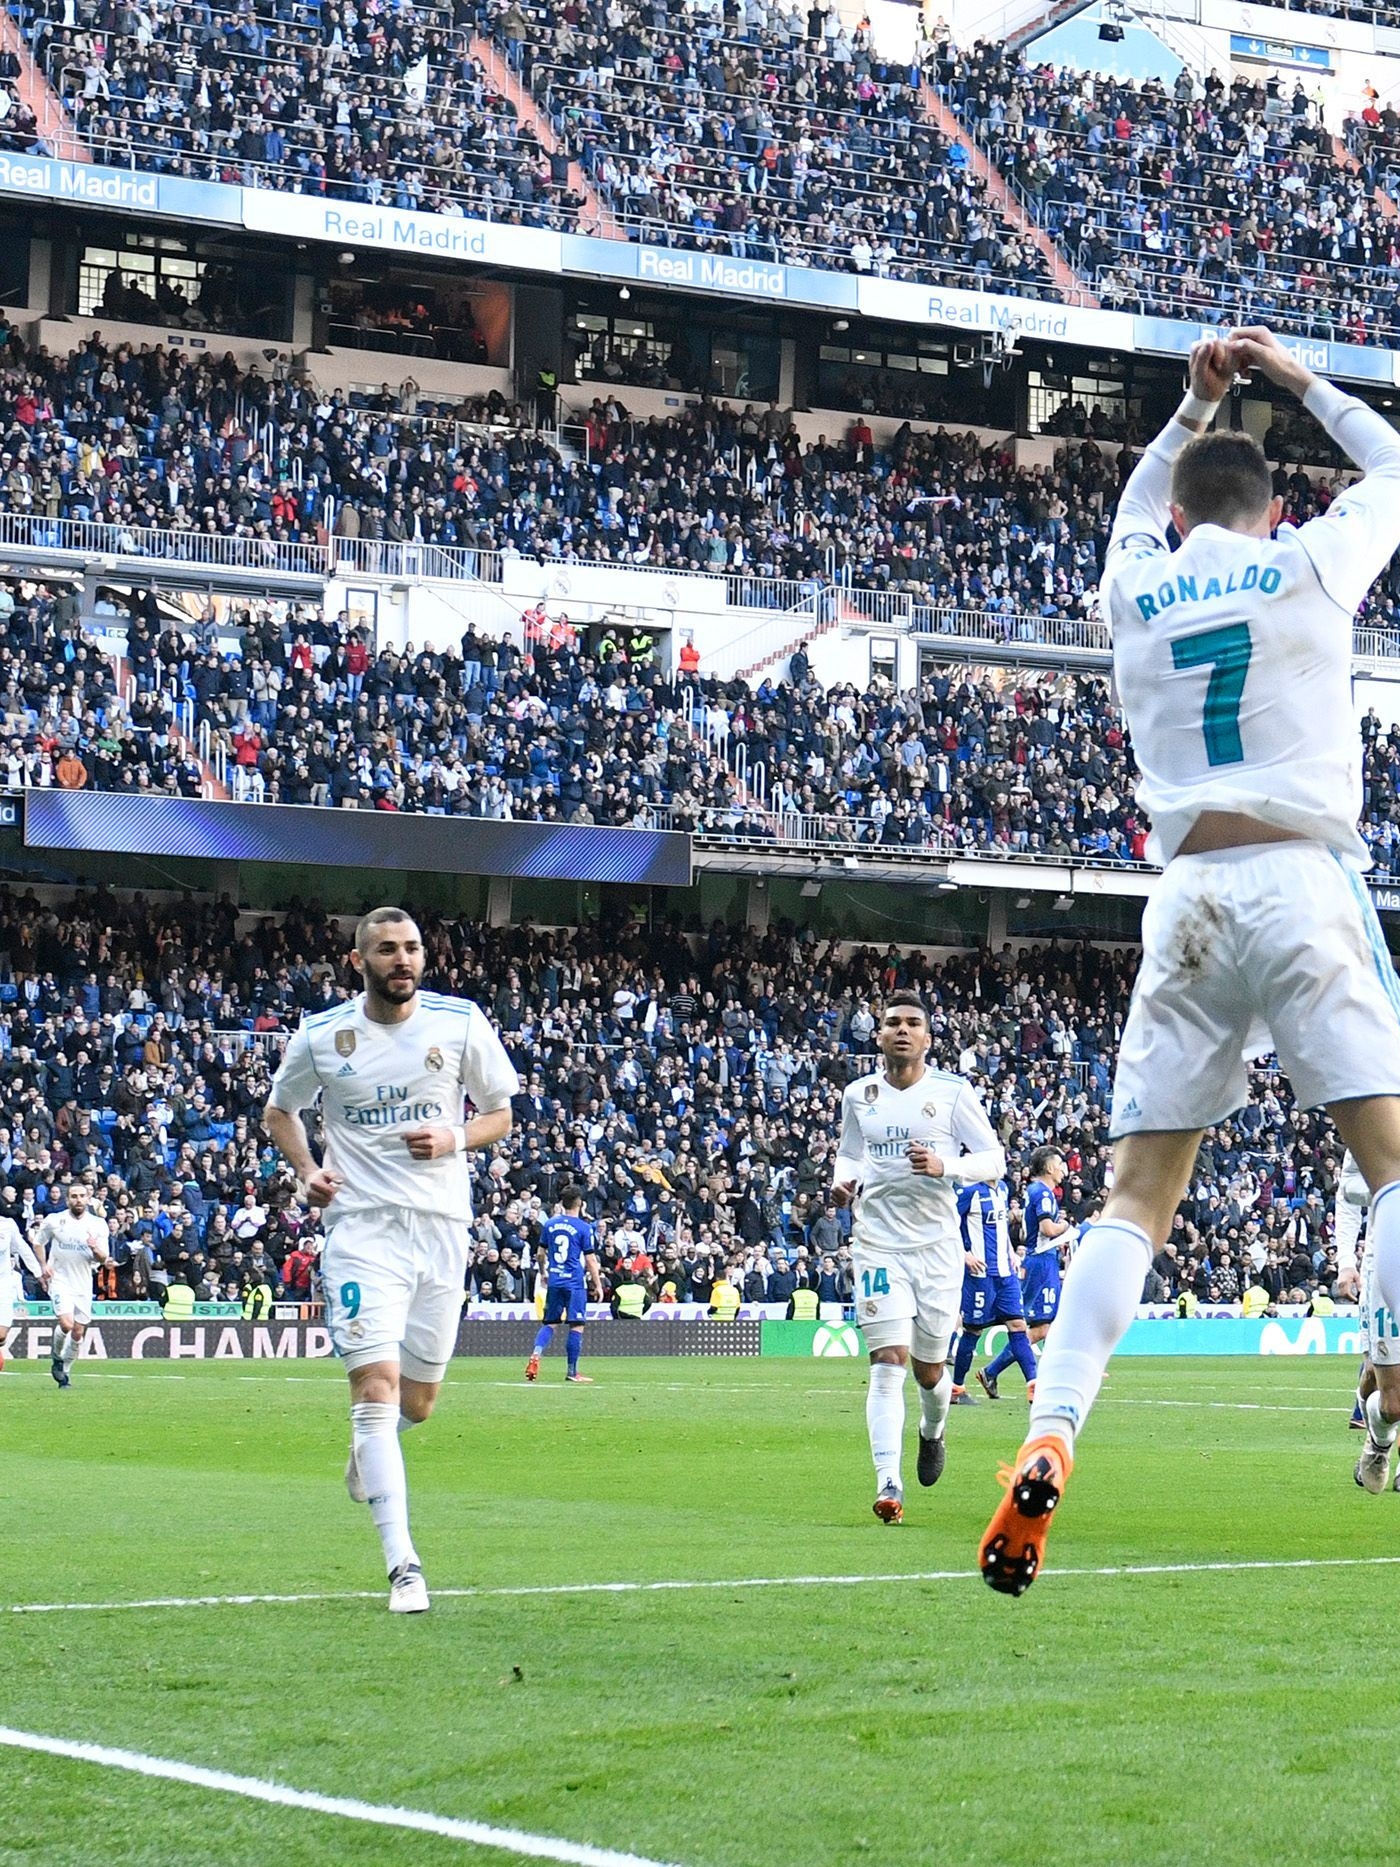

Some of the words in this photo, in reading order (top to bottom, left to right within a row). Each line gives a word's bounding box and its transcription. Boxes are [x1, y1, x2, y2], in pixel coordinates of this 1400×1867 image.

[60, 166, 155, 205] Madrid
[325, 211, 382, 239] Real
[394, 221, 485, 254] Madrid
[640, 250, 693, 281] Real
[701, 259, 784, 293] Madrid
[929, 298, 979, 323] Real
[1289, 342, 1328, 368] drid
[1136, 564, 1282, 621] RONALDO
[1170, 621, 1253, 767] 7
[377, 1085, 408, 1101] Fly
[343, 1101, 442, 1125] Emirates
[886, 1125, 910, 1139] Fly
[554, 1234, 569, 1264] 3
[861, 1267, 890, 1298] 14
[1042, 1288, 1056, 1304] 16
[340, 1280, 361, 1320] 9
[974, 1291, 985, 1308] 5
